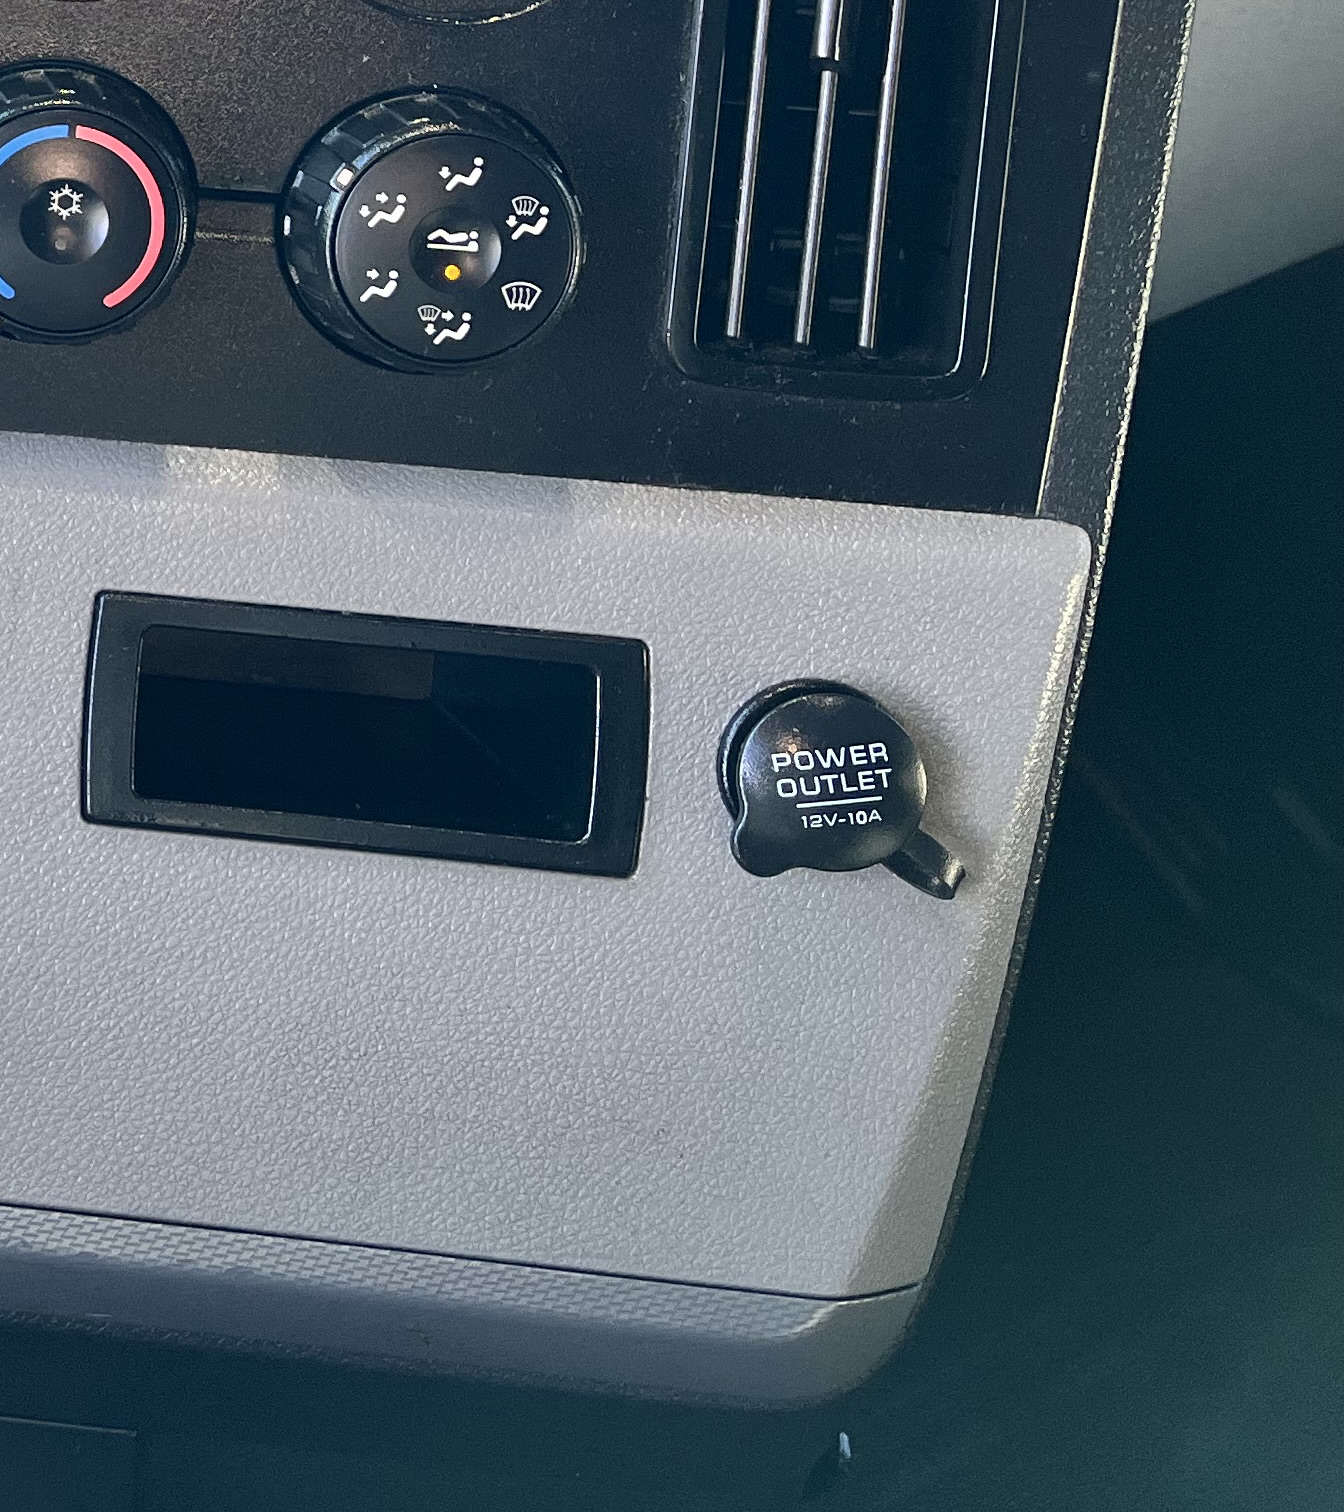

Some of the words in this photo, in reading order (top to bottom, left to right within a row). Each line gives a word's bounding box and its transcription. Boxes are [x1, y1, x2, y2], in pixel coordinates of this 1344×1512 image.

[771, 742, 890, 773] POWER
[776, 768, 893, 798] OUTLET
[800, 809, 883, 829] 12V-10A
